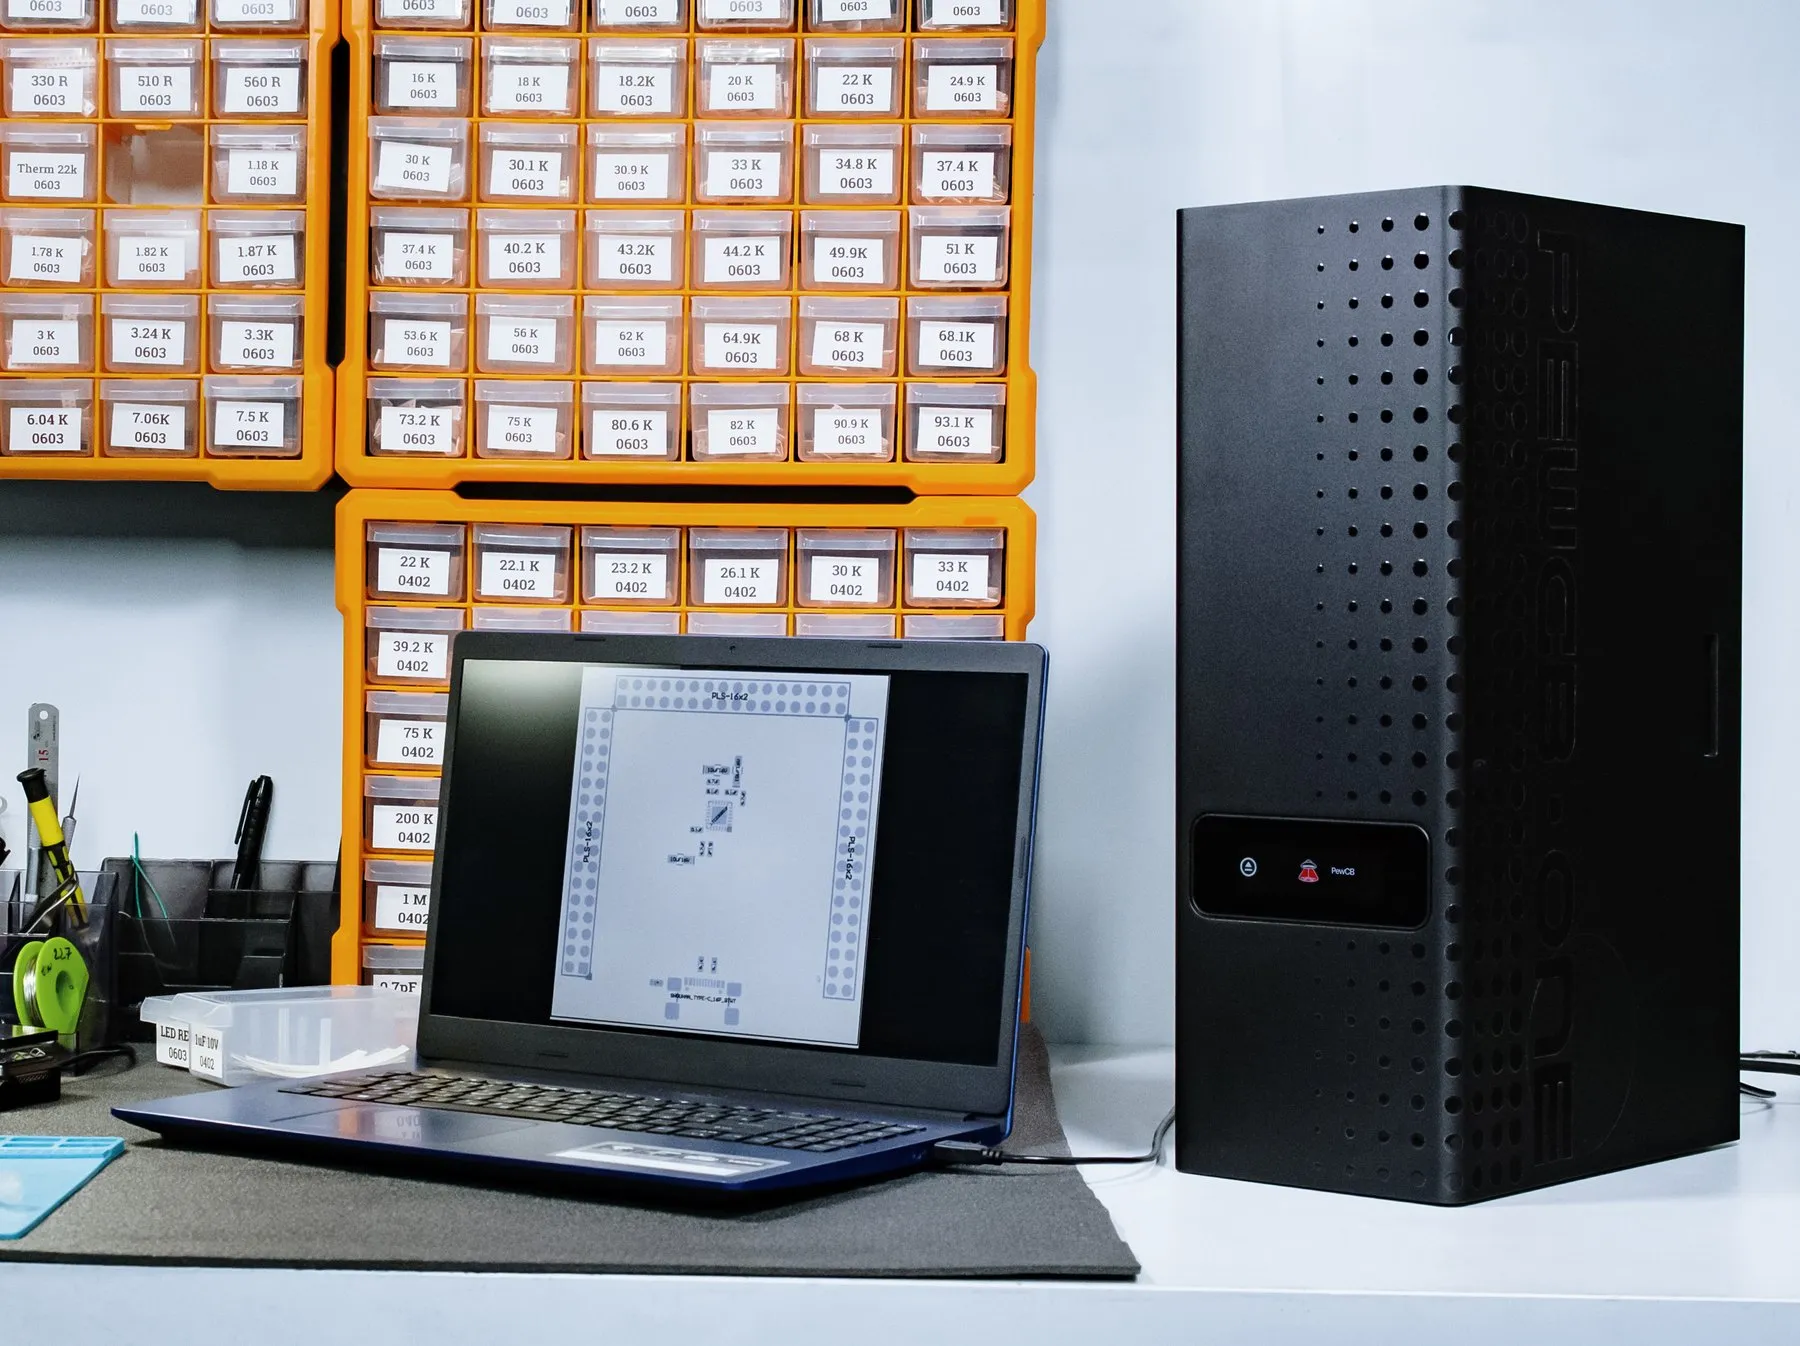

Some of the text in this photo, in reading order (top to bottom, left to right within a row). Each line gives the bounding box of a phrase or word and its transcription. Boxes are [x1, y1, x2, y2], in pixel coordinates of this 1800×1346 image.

[30, 0, 61, 12] 0603
[141, 4, 172, 15] 0603
[242, 3, 273, 14] 0603
[403, 0, 434, 10] 0603
[730, 1, 762, 12] 0603
[841, 2, 867, 11] 0603
[516, 7, 548, 18] 0603
[626, 6, 657, 17] 0603
[953, 7, 980, 15] 0603
[32, 76, 67, 86] 330 R
[138, 76, 172, 86] 510 R
[245, 77, 280, 87] 560 R
[413, 73, 435, 83] 16 K
[620, 76, 654, 86] 18.2K
[843, 74, 872, 85] 22 K
[951, 77, 985, 86] 24.9 K
[411, 89, 437, 98] 0603
[841, 94, 873, 104] 0603
[954, 93, 981, 102] 0603
[34, 95, 65, 105] 0603
[140, 95, 171, 105] 0603
[247, 96, 278, 106] 0603
[621, 95, 652, 106] 0603
[17, 164, 77, 174] Therm 22k
[509, 160, 548, 171] 30.1 K
[732, 159, 761, 170] 33 K
[836, 159, 876, 169] 34.8 K
[937, 161, 978, 171] 37.4 K
[34, 180, 60, 189] 0603
[512, 179, 543, 190] 0603
[731, 178, 762, 189] 0603
[841, 178, 872, 188] 0603
[942, 180, 973, 191] 0603
[32, 247, 63, 257] 1.78 K
[238, 245, 276, 257] 1.87 K
[402, 244, 435, 254] 37.4 K
[504, 243, 545, 253] 40.2 K
[618, 244, 654, 255] 43.2K
[723, 245, 764, 256] 44.2 K
[830, 247, 867, 258] 49.9K
[947, 244, 974, 254] 51 K
[34, 263, 59, 273] 0603
[243, 264, 274, 276] 0603
[405, 260, 431, 270] 0603
[509, 262, 540, 273] 0603
[620, 263, 651, 274] 0603
[729, 265, 760, 276] 0603
[944, 263, 976, 274] 0603
[832, 267, 863, 277] 0603
[37, 331, 54, 339] 3 K
[131, 328, 171, 339] 3.24 K
[245, 329, 273, 340] 3.3K
[404, 331, 437, 341] 53.6 K
[514, 328, 537, 338] 56 K
[620, 332, 643, 340] 62 K
[723, 333, 760, 344] 64.9K
[835, 331, 863, 342] 68 K
[939, 331, 975, 342] 68.1K
[33, 346, 59, 355] 0603
[135, 347, 166, 358] 0603
[243, 348, 274, 359] 0603
[407, 347, 433, 356] 0603
[512, 344, 538, 354] 0603
[619, 348, 645, 356] 0603
[726, 352, 757, 363] 0603
[832, 350, 863, 362] 0603
[940, 350, 972, 361] 0603
[28, 414, 68, 425] 6.04 K
[133, 413, 169, 424] 7.06K
[237, 411, 268, 422] 7.5 K
[400, 414, 440, 426] 73.2 K
[935, 416, 974, 427] 93.1 K
[612, 420, 652, 430] 80.6 K
[32, 433, 63, 444] 0603
[135, 432, 166, 443] 0603
[237, 430, 268, 441] 0603
[403, 433, 435, 445] 0603
[617, 439, 648, 449] 0603
[938, 436, 969, 447] 0603
[401, 556, 430, 568] 22 K
[500, 560, 539, 571] 22.1 K
[939, 561, 967, 572] 33 K
[612, 563, 651, 573] 23.2 K
[721, 568, 759, 578] 26.1 K
[832, 565, 861, 576] 30 K
[399, 575, 430, 587] 0402
[504, 579, 535, 590] 0402
[937, 581, 968, 591] 0402
[616, 582, 647, 592] 0402
[725, 587, 756, 597] 0402
[831, 584, 862, 595] 0402
[393, 641, 433, 653] 39.2 K
[397, 660, 428, 671] 0402
[711, 691, 749, 702] PLS-16x2
[404, 728, 432, 739] 75 K
[402, 747, 433, 758] 0402
[396, 813, 433, 824] 200 K
[399, 832, 430, 843] 0402
[1331, 867, 1355, 876] PewCB
[403, 894, 427, 905] 1 M
[399, 912, 430, 925] 0402
[160, 1025, 189, 1042] LED RE
[207, 1037, 219, 1051] 10V
[168, 1046, 187, 1062] 0603
[199, 1055, 215, 1070] 0402
